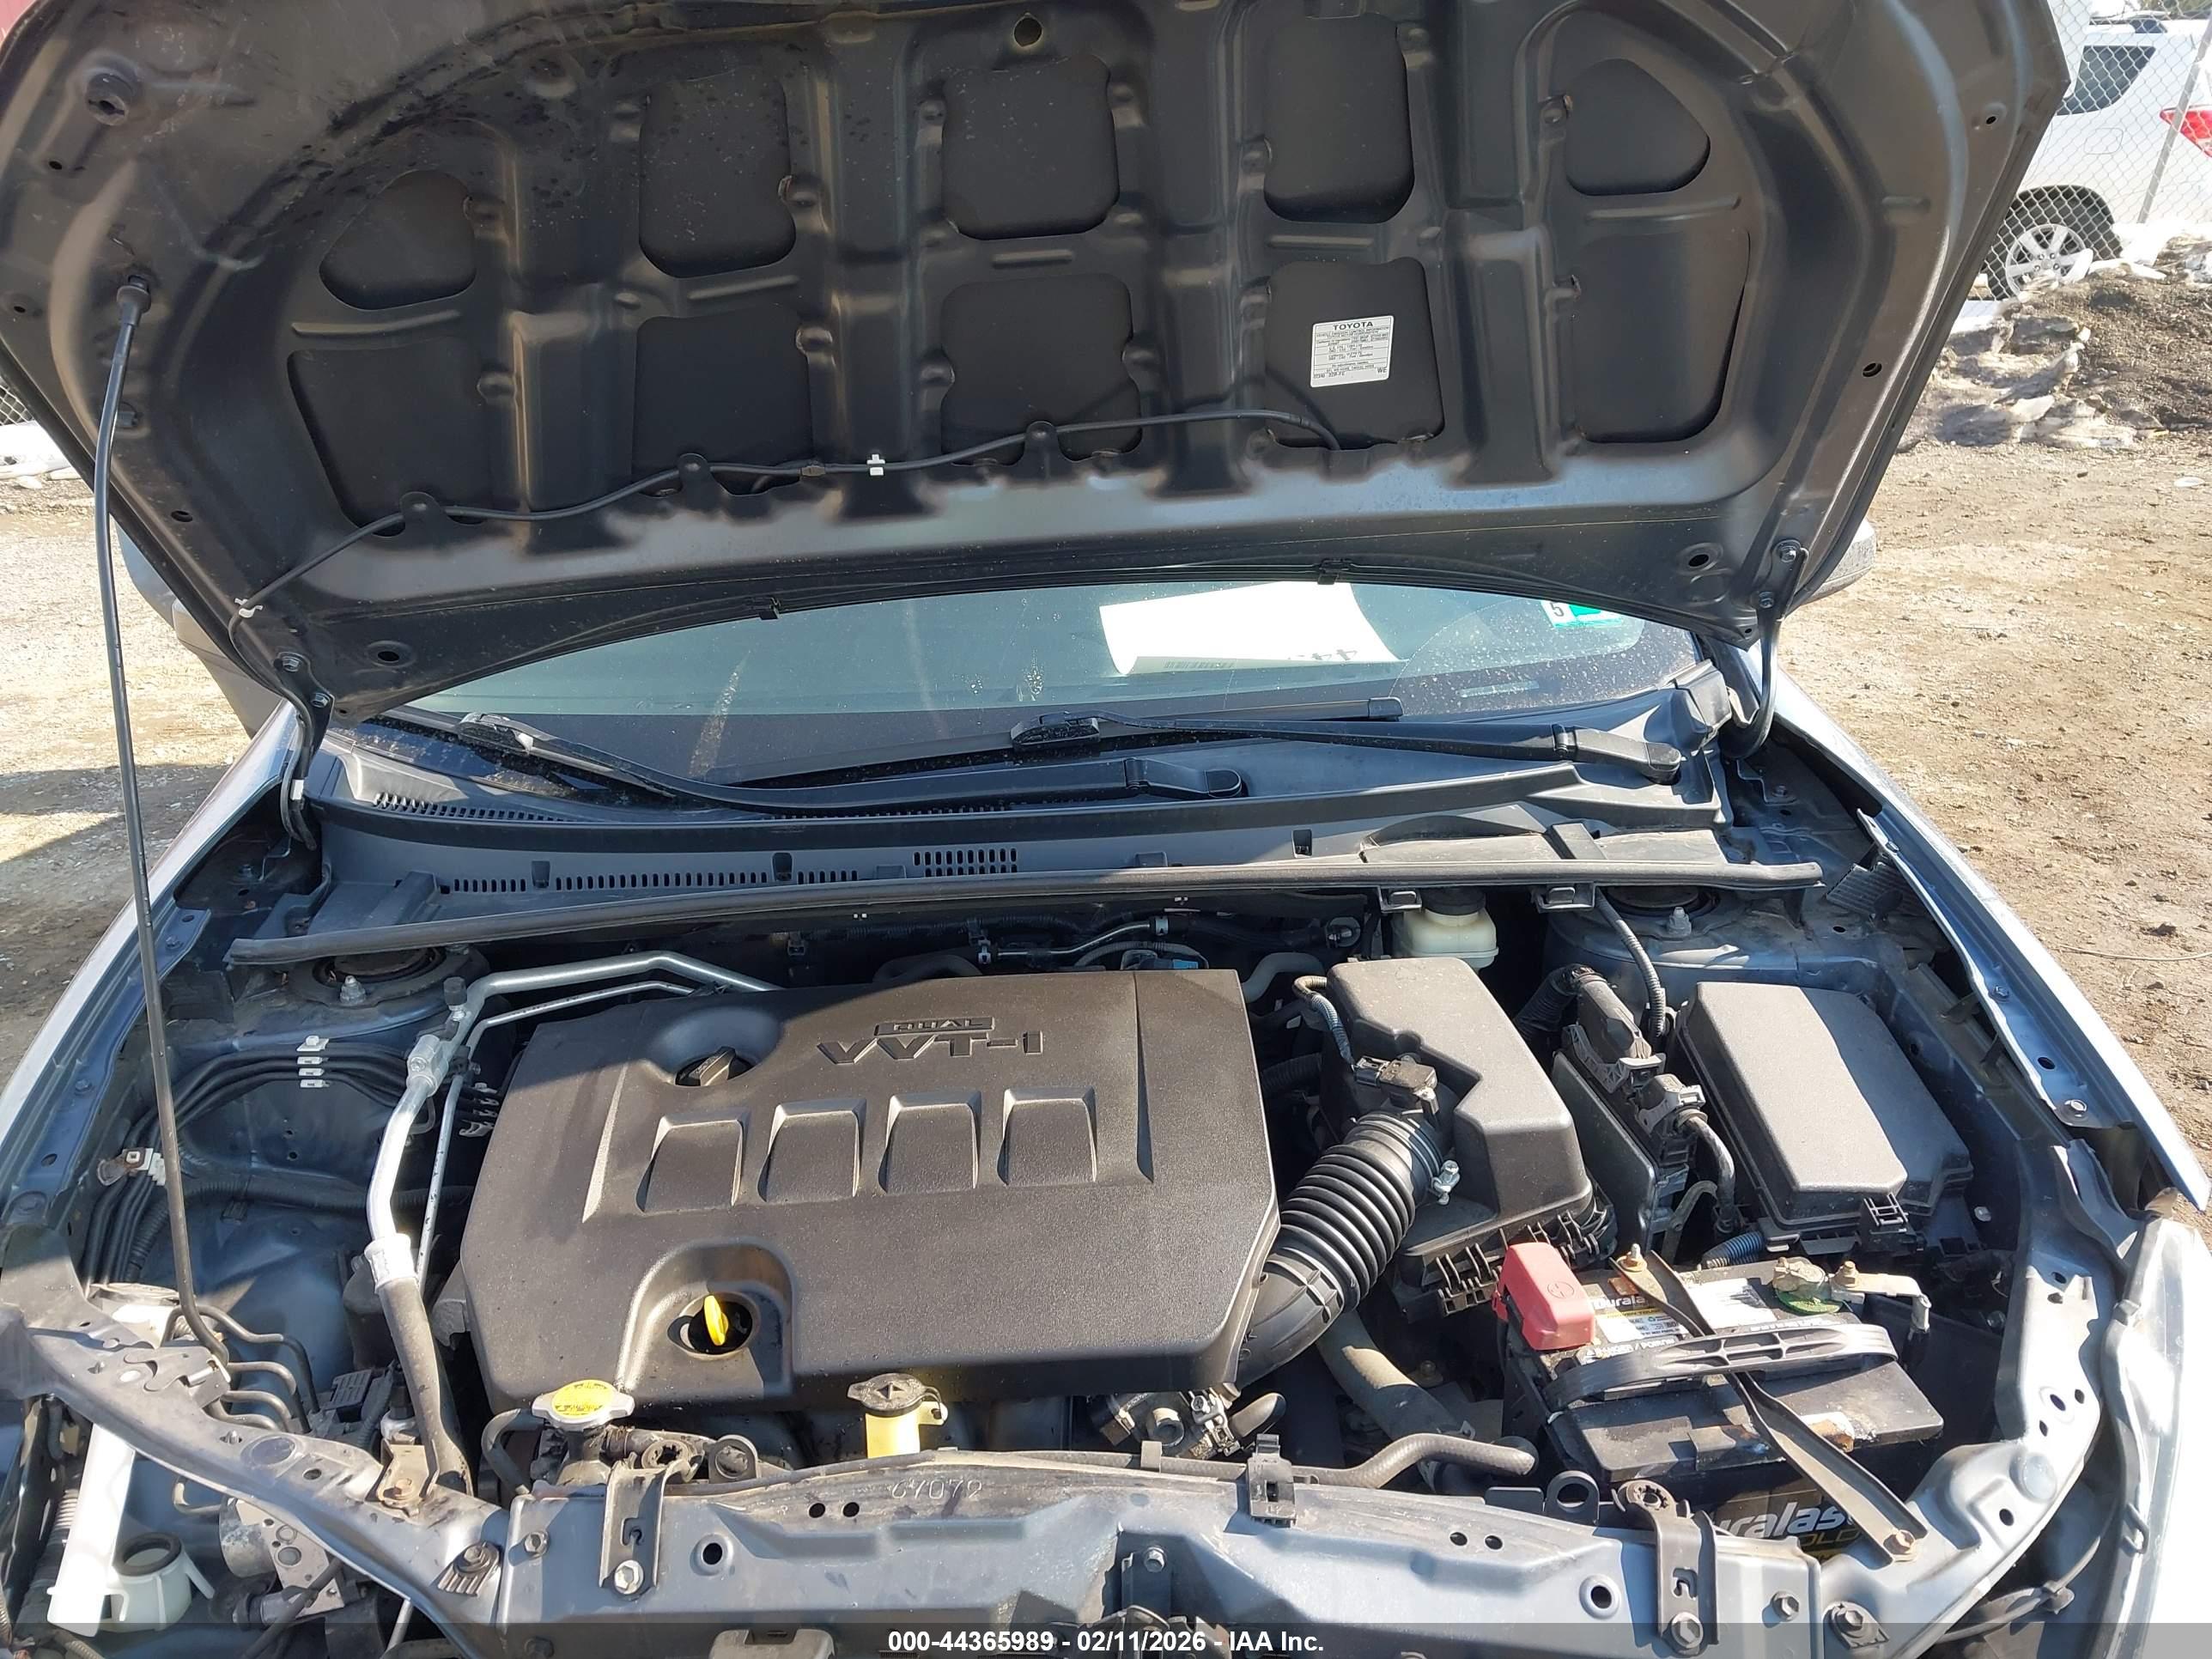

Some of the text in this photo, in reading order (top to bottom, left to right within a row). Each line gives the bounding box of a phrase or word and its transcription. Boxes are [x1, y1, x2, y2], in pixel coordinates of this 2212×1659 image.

[1332, 321, 1374, 331] TOYOTA
[893, 1017, 983, 1031] DUAL
[1593, 1294, 1646, 1310] Durala
[1711, 1502, 1853, 1540] uralas
[1802, 1528, 1862, 1546] OLD
